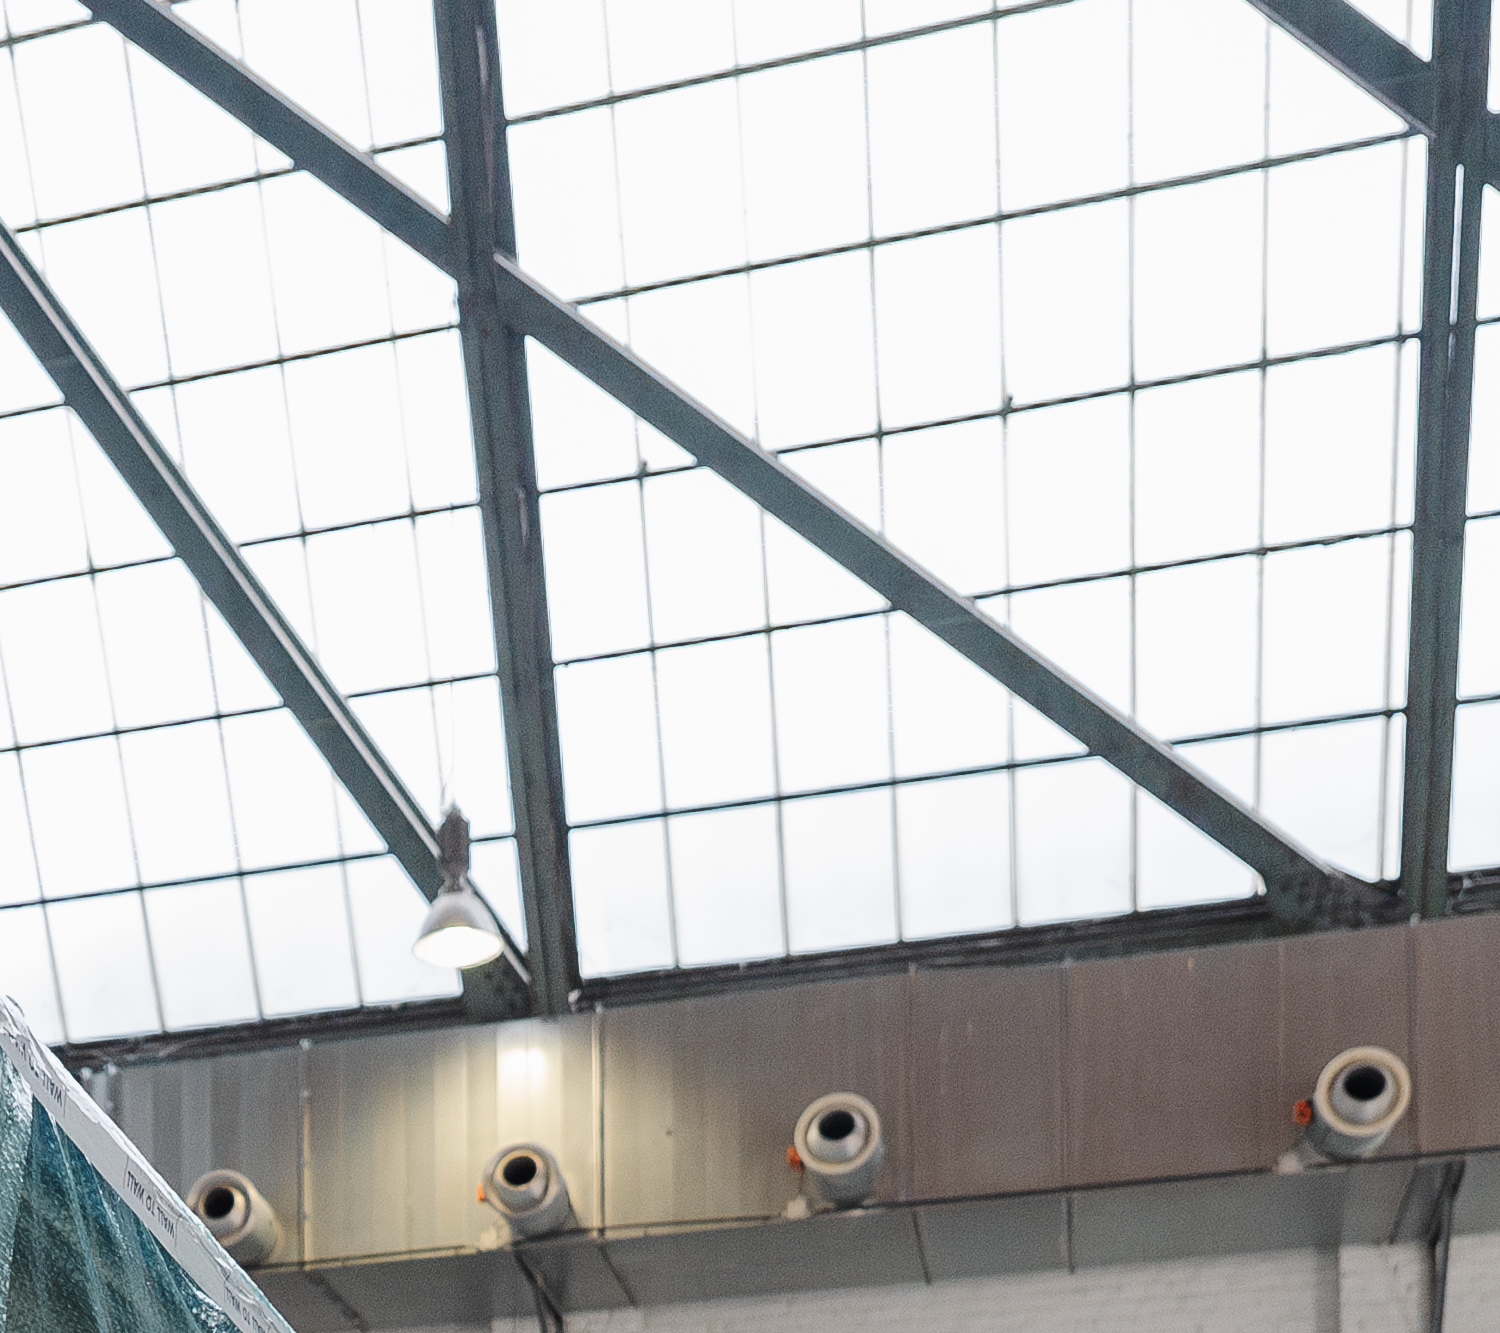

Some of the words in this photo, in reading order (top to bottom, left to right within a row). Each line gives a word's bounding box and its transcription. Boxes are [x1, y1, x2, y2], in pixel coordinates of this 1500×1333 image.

[126, 1170, 145, 1205] WALL
[146, 1195, 155, 1217] TO
[156, 1206, 175, 1238] WALL
